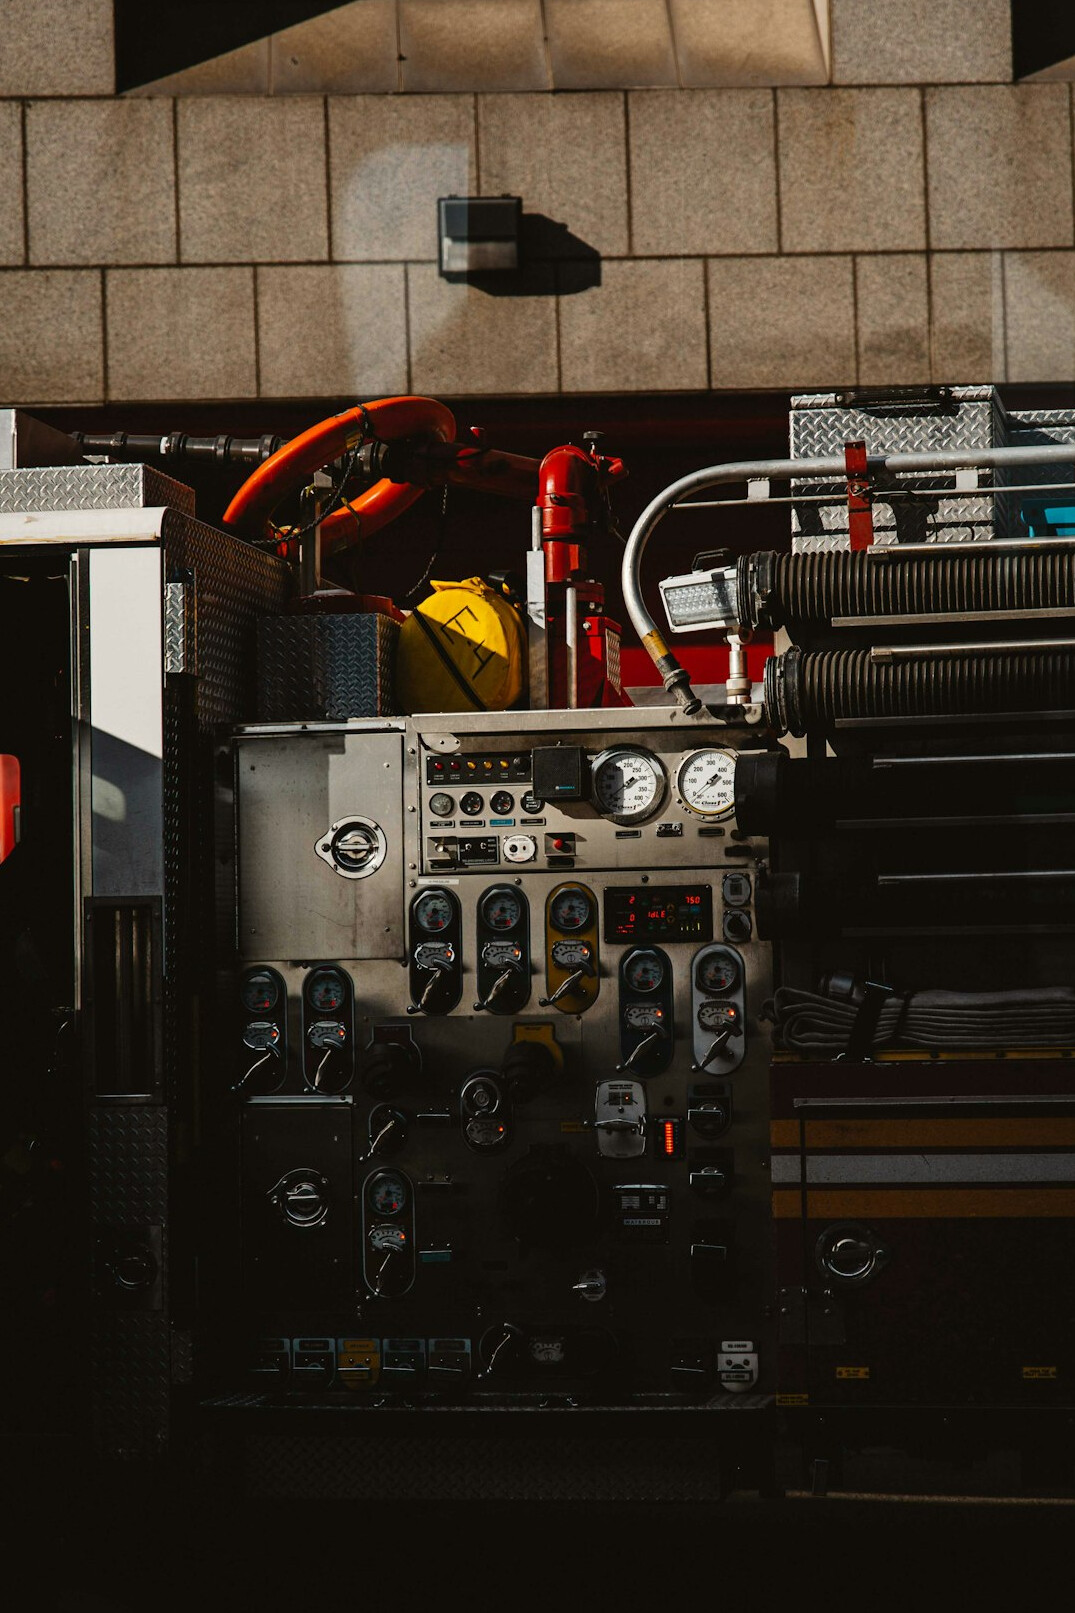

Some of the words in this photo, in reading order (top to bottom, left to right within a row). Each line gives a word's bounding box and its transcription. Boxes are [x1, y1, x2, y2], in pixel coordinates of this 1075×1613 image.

[629, 895, 635, 904] 2
[685, 896, 701, 905] 750
[629, 913, 635, 922] 0
